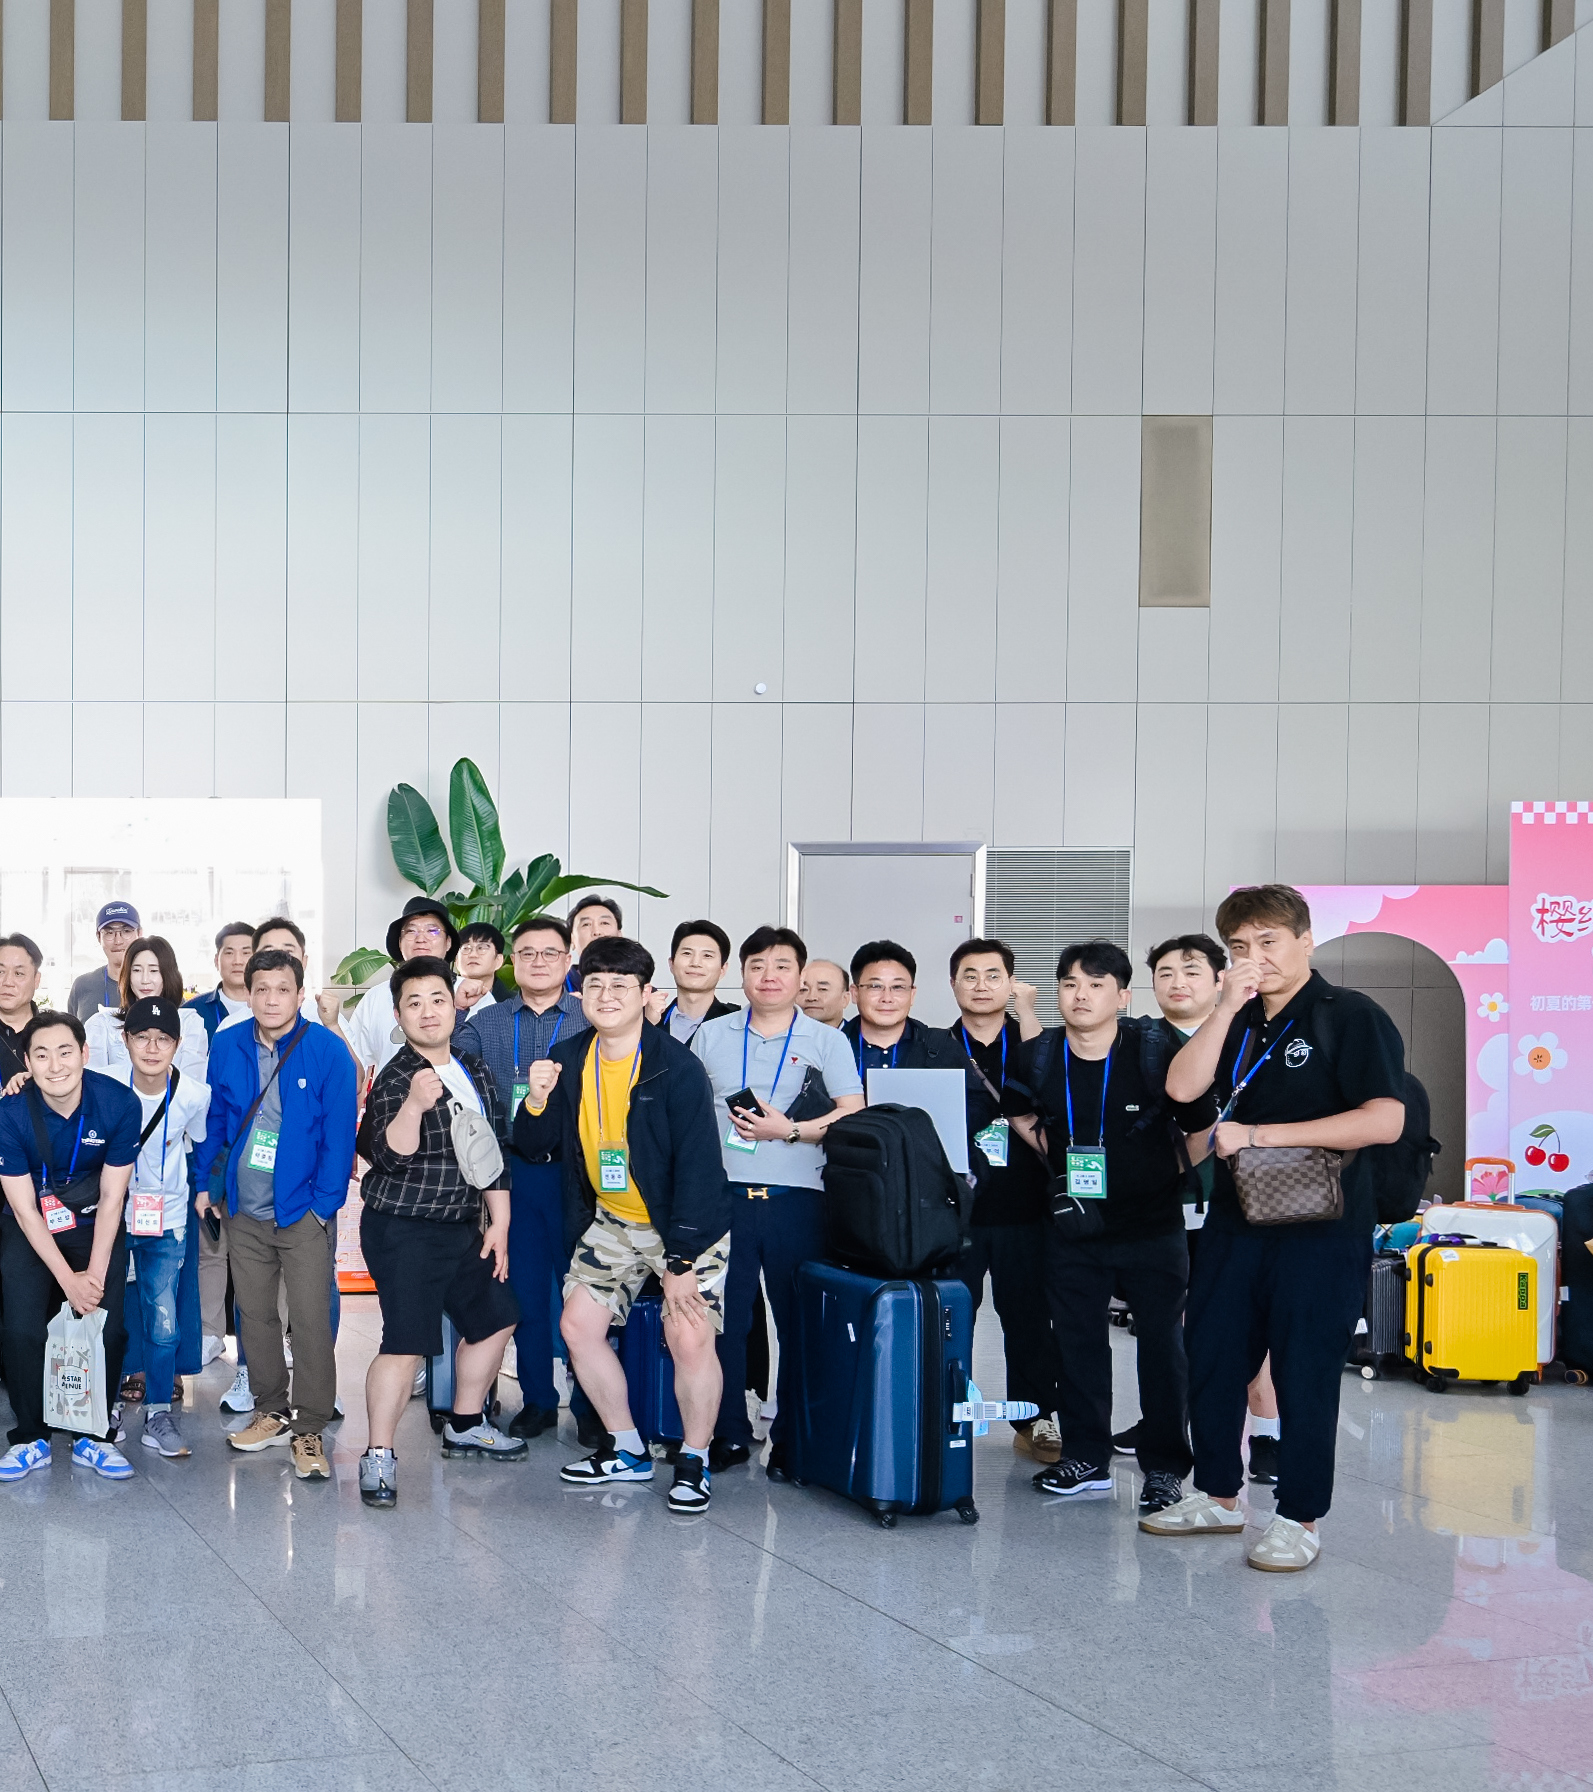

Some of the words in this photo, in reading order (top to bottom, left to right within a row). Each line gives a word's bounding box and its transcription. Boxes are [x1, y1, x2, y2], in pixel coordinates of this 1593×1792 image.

[1530, 995, 1593, 1011] 初夏的第
[1519, 1274, 1527, 1309] Kappa
